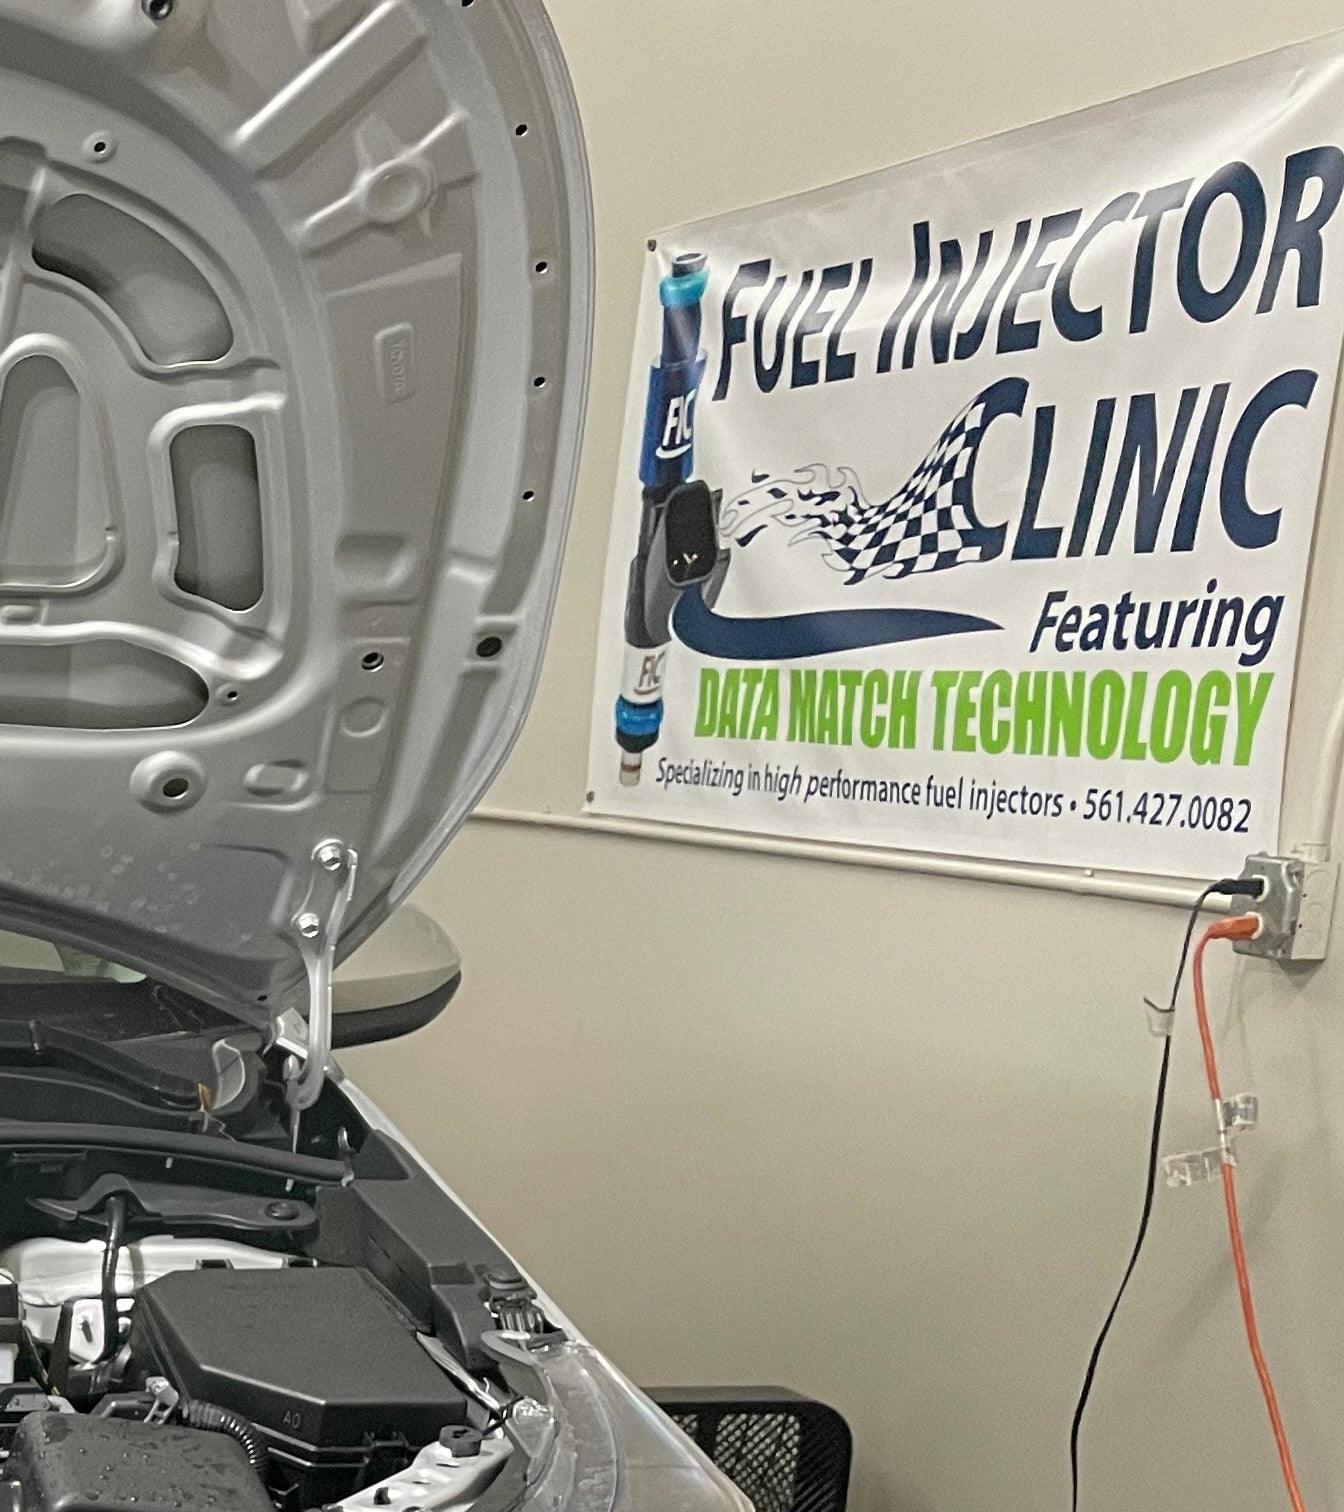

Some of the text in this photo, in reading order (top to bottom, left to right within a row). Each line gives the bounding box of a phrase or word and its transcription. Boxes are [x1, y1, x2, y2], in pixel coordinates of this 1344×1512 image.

[712, 145, 1344, 402] FUEL INJECTOR
[952, 369, 1318, 562] CLINIC
[1029, 578, 1285, 667] Featuring
[694, 668, 1275, 766] DATA MATCH TECHNOLOGY
[656, 757, 1252, 833] Specializing in high performance fuel injectors 561.427.0082
